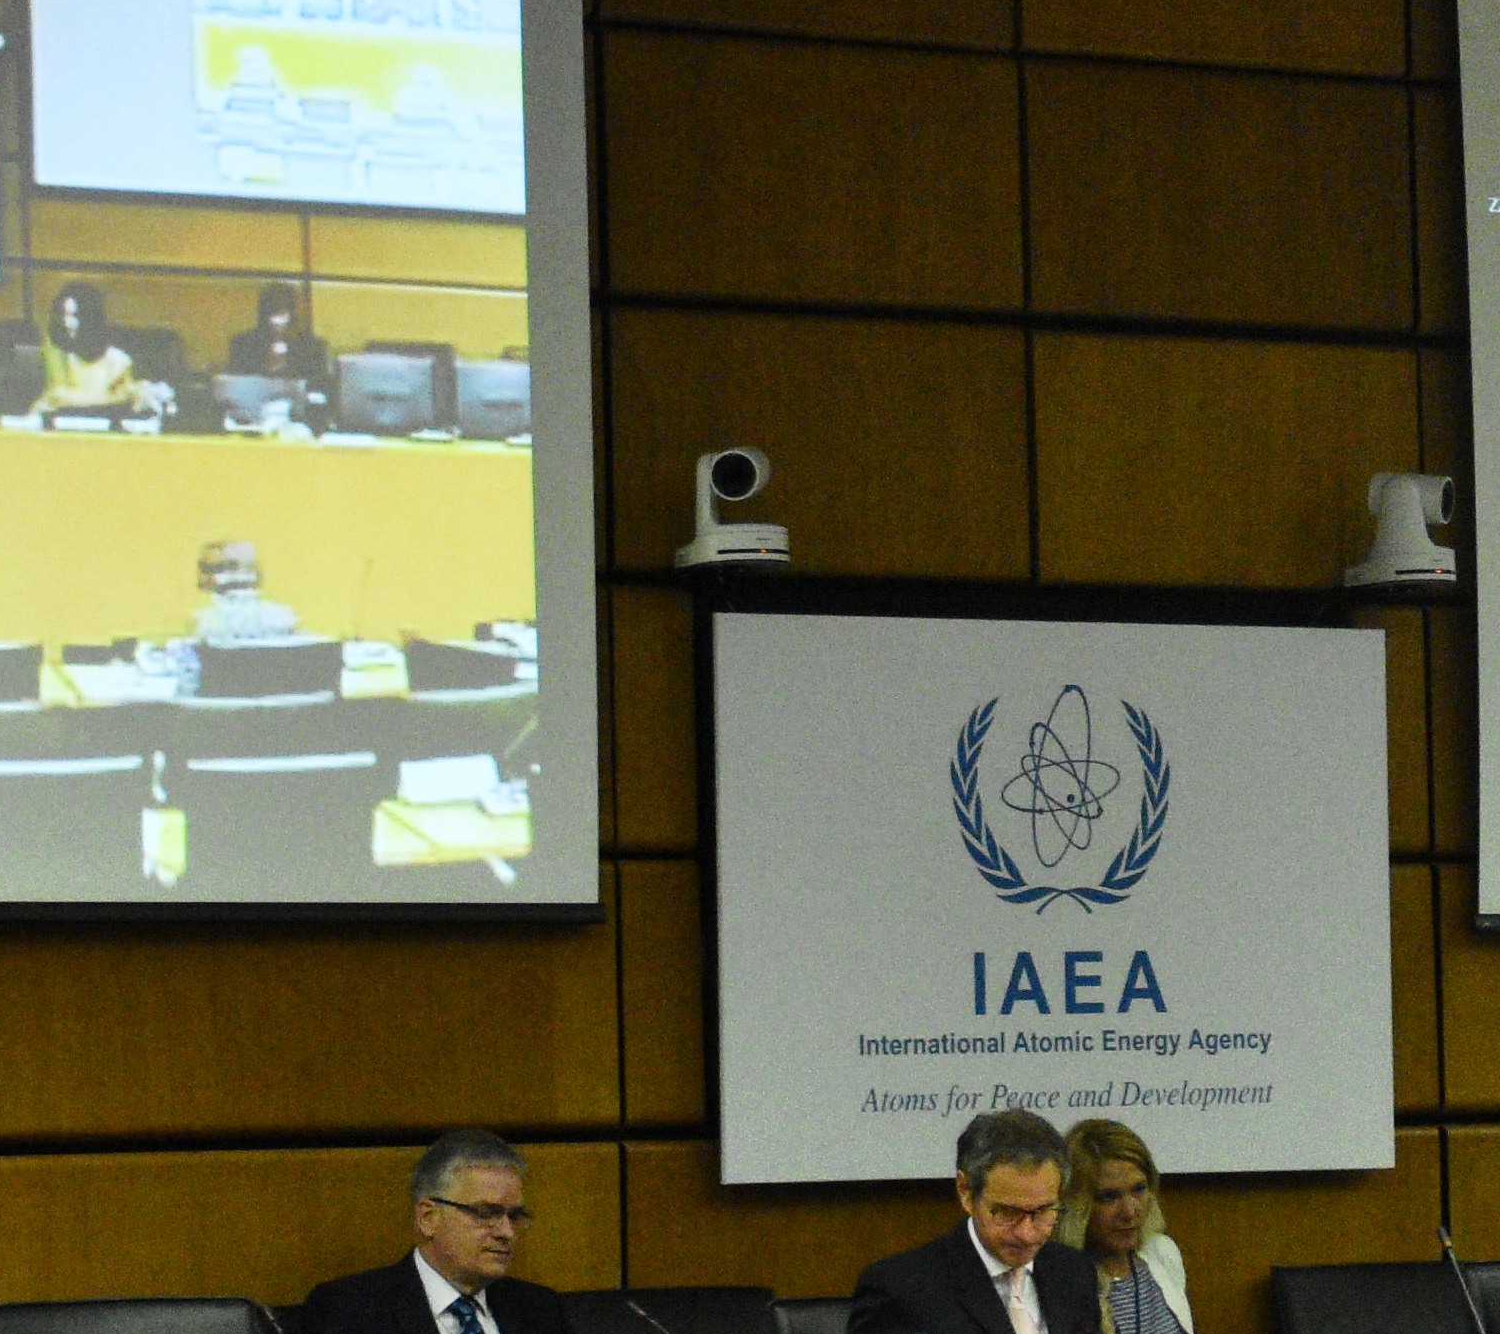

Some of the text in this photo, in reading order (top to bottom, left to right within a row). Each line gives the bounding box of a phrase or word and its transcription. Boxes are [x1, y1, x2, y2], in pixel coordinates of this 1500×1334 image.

[973, 949, 1168, 1016] IAEA
[858, 1028, 1272, 1057] International Atomic Energy Agency
[861, 1079, 1274, 1118] Atoms for Peace and Development
